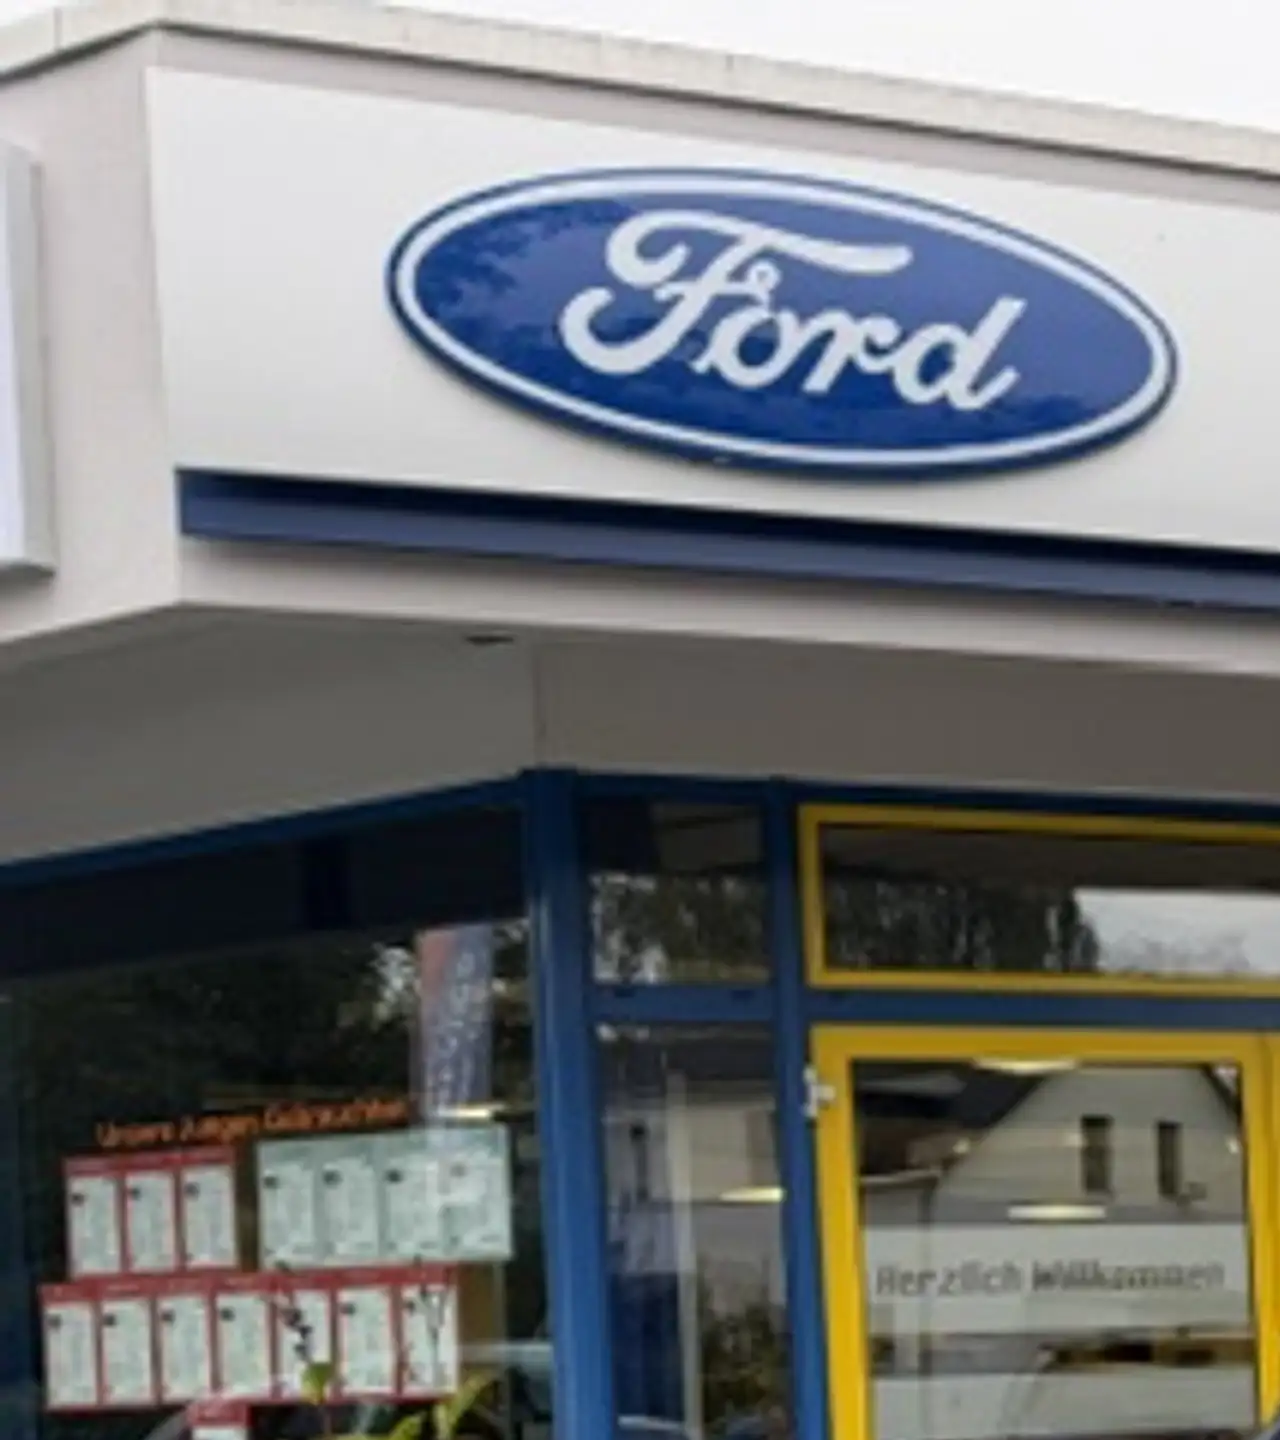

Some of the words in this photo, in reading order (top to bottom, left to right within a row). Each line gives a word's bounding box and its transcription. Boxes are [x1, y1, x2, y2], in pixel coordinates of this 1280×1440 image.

[556, 207, 1027, 412] Ford
[876, 1260, 1024, 1297] Herzlich
[1030, 1259, 1226, 1292] Willkommen
